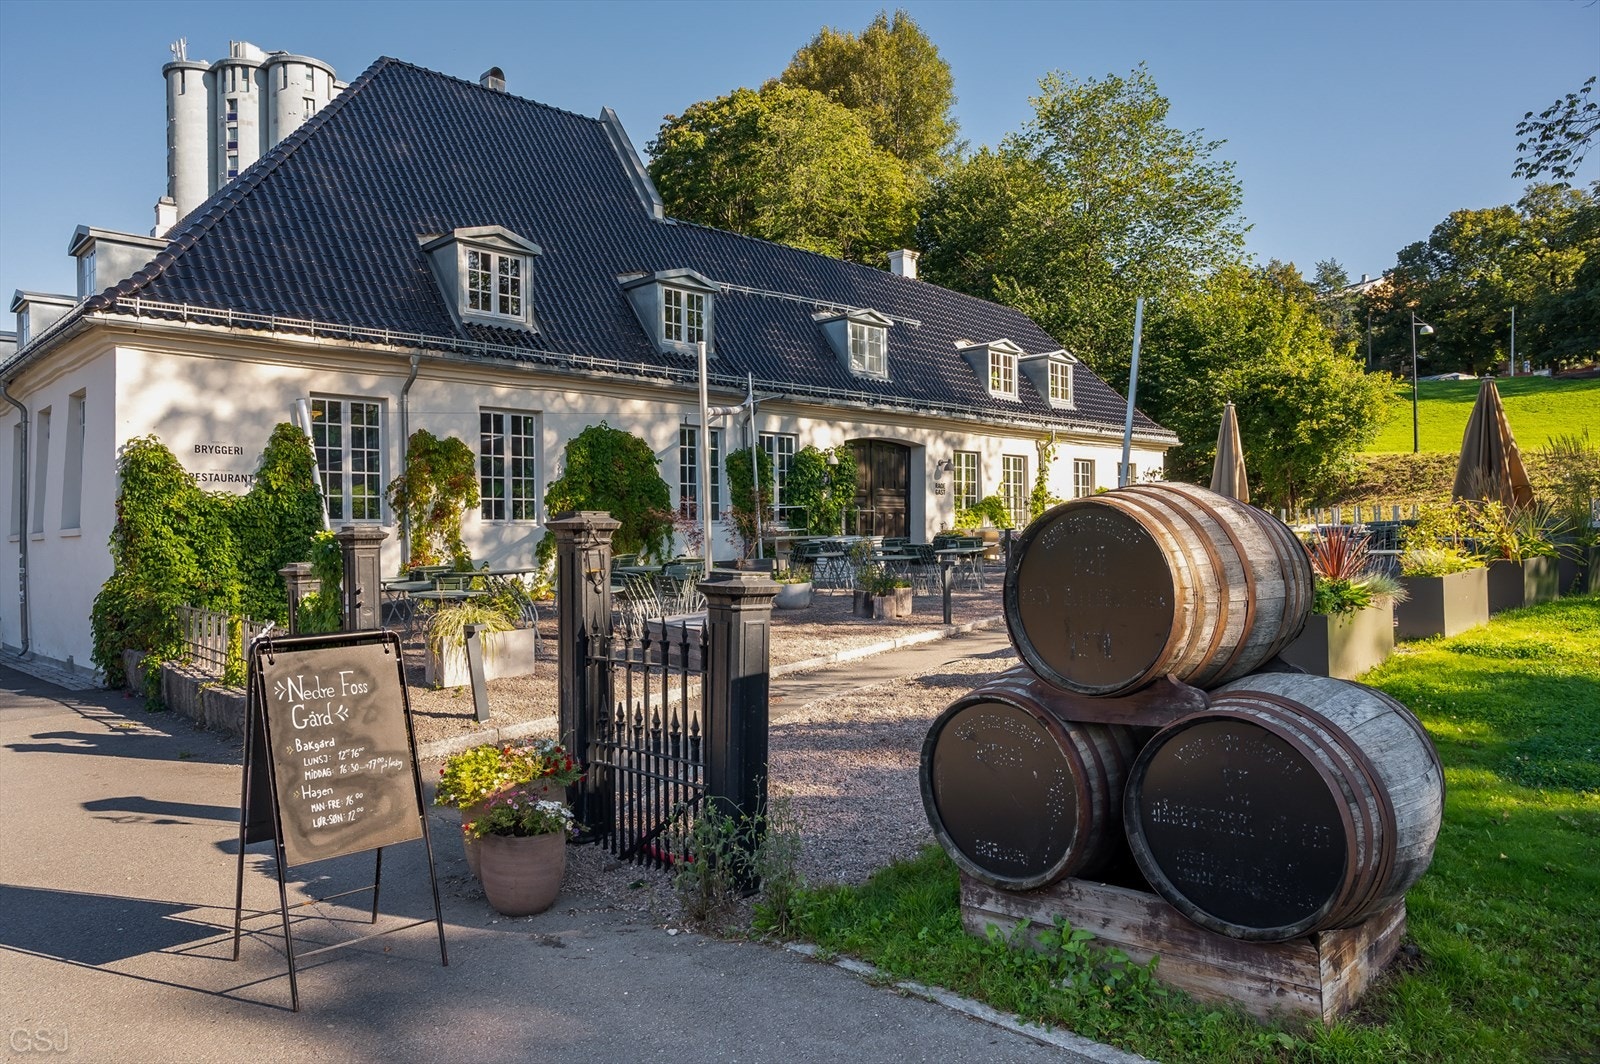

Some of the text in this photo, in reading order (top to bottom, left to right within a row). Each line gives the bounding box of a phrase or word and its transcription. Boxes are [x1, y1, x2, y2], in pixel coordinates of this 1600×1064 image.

[194, 444, 243, 455] BRYGGERI
[287, 670, 368, 702] Nedre Foss
[291, 702, 334, 730] Gård
[294, 737, 336, 753] Bakgård
[301, 784, 334, 800] Hagen
